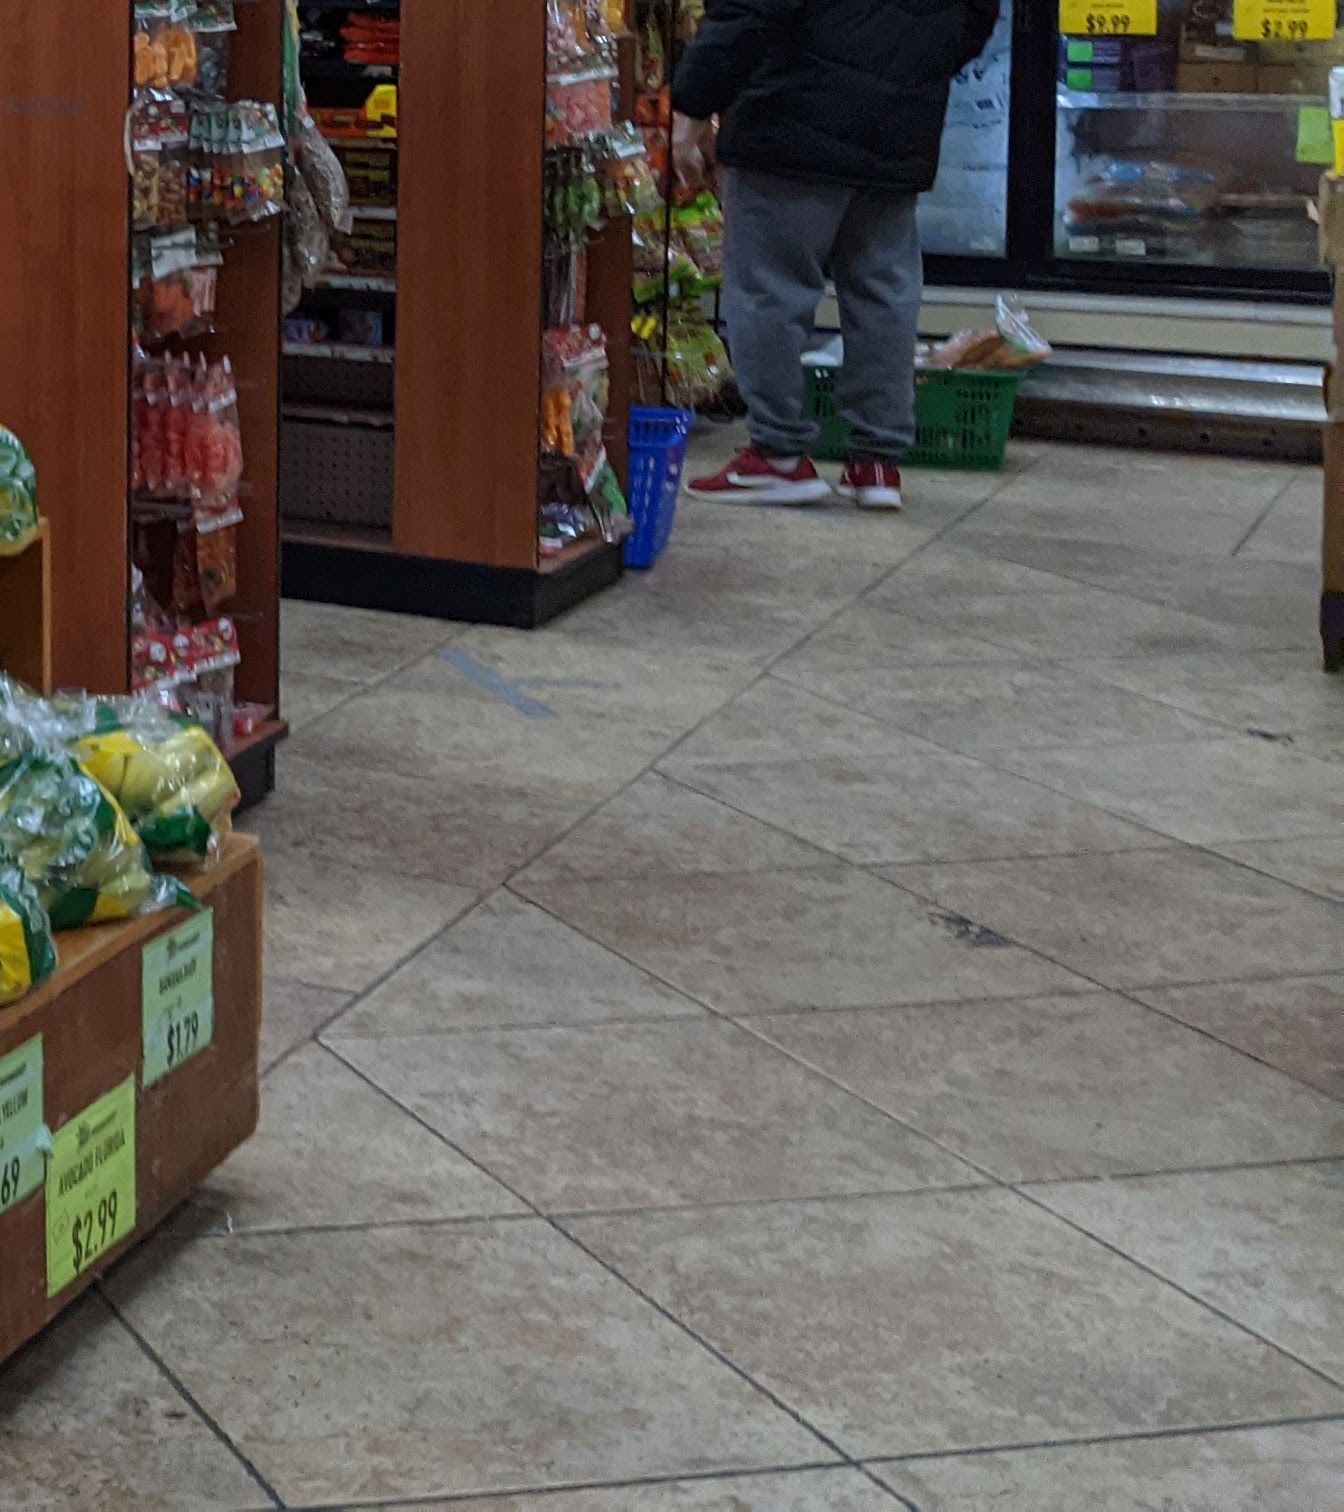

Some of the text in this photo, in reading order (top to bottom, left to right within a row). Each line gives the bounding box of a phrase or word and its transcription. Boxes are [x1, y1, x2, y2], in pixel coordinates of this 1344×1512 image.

[1086, 13, 1131, 34] $9.99
[2, 1087, 29, 1121] YELLOW
[59, 1151, 94, 1196] AVOCADO
[72, 1189, 118, 1275] $2.99
